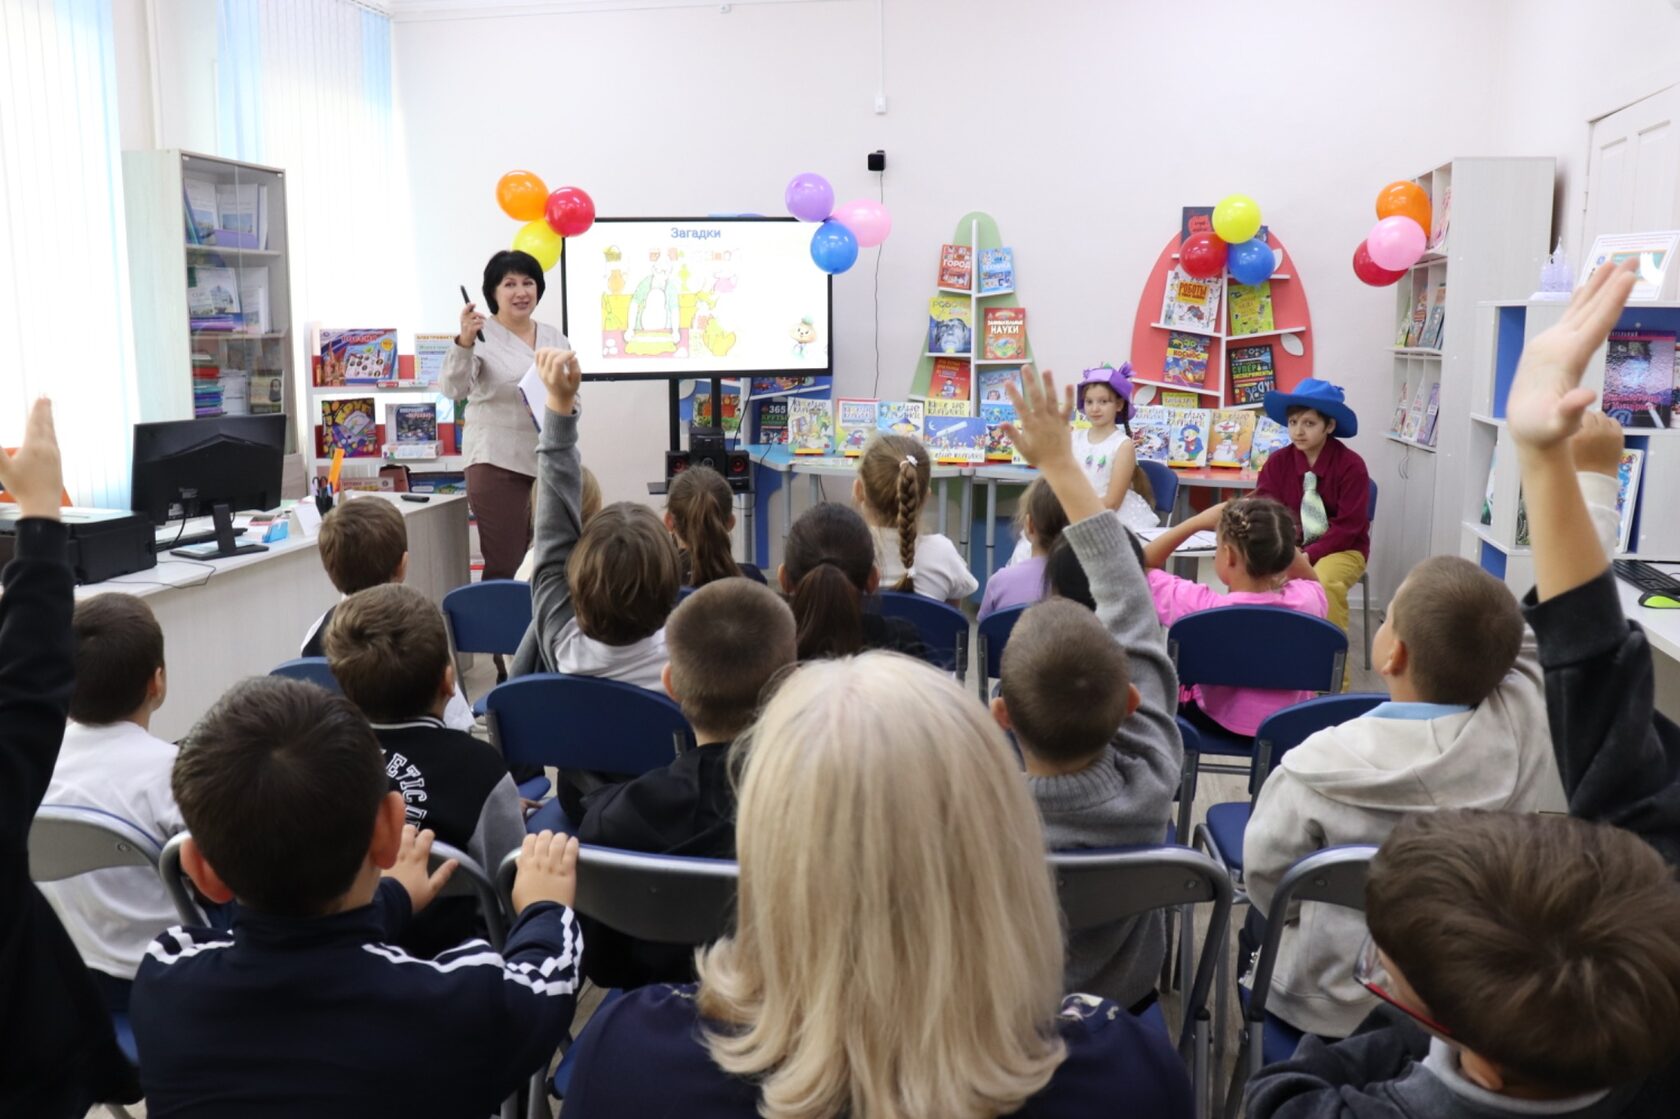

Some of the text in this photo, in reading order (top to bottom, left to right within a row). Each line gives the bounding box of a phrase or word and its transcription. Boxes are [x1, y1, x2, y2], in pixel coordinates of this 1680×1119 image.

[671, 227, 721, 240] Загадки
[991, 325, 1019, 334] НАУКИ
[769, 405, 786, 414] 365
[380, 748, 428, 803] ETIC
